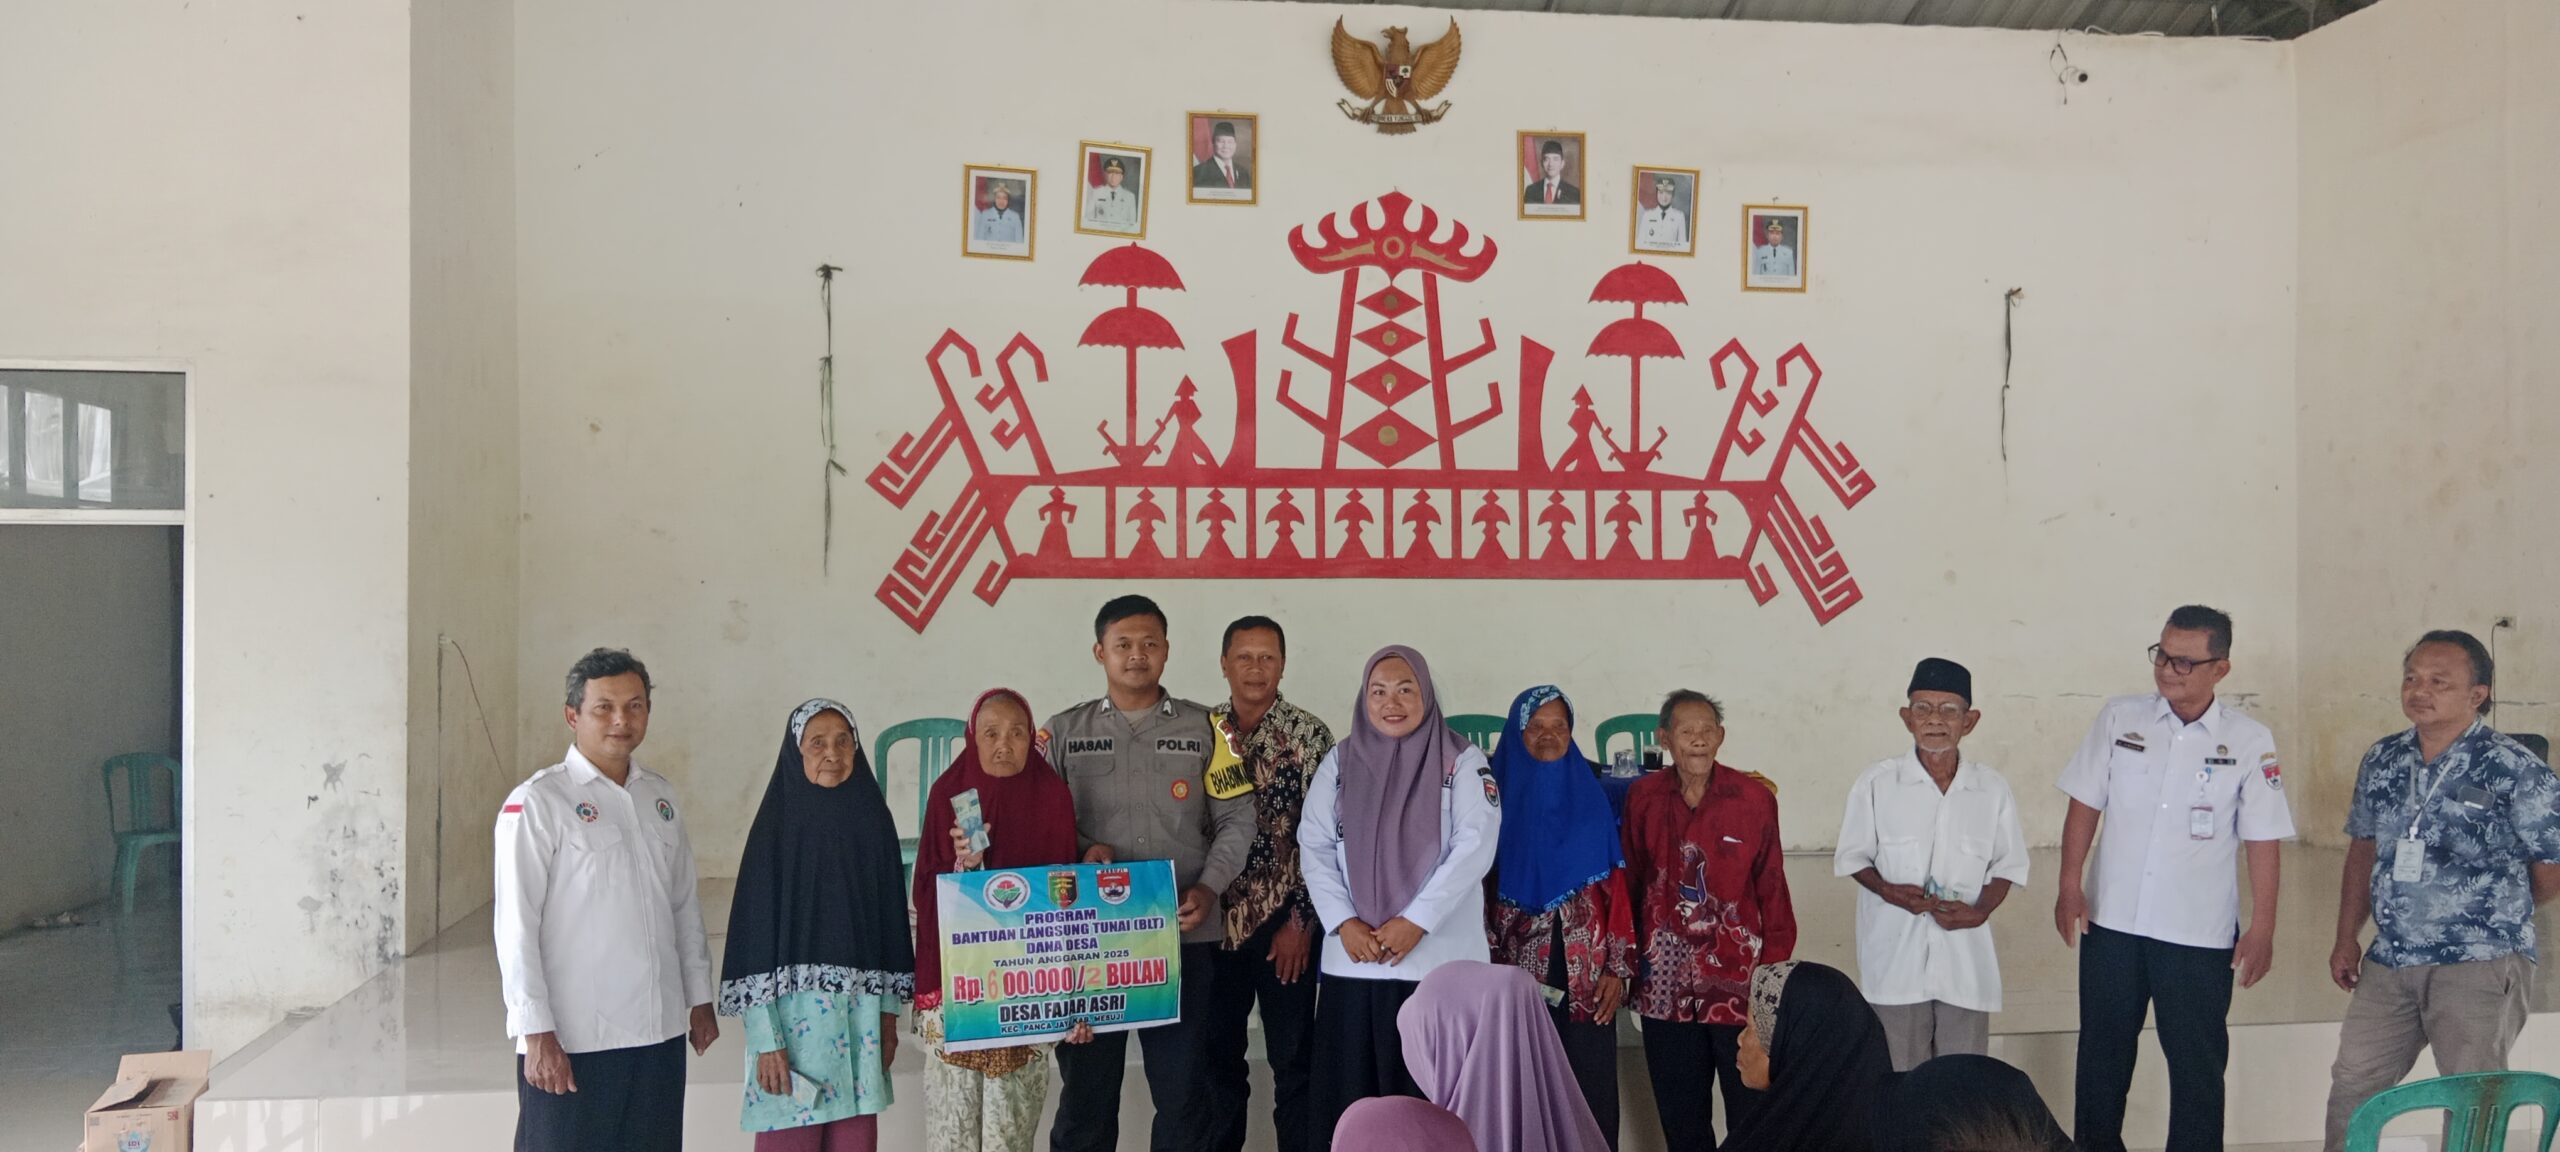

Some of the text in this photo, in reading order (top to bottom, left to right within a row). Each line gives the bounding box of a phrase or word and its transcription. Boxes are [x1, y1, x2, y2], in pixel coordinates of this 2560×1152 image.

[1068, 738, 1113, 753] HASAN
[1156, 739, 1200, 753] POLRI
[1025, 909, 1097, 925] PROGRAM
[952, 917, 1164, 945] BANTUAN LANGSUNG TUNAI (BLT)
[1026, 937, 1098, 954] DANA DESA
[993, 949, 1129, 968] TAHUN ANGGARAN 2025
[953, 975, 984, 1004] Rp.
[1106, 958, 1166, 988] BULAN
[1000, 994, 1125, 1023] DESA FAJAR ASRI
[1001, 1024, 1020, 1033] KEC.
[1023, 1021, 1052, 1031] PANCA
[1094, 1013, 1124, 1022] MESUJI
